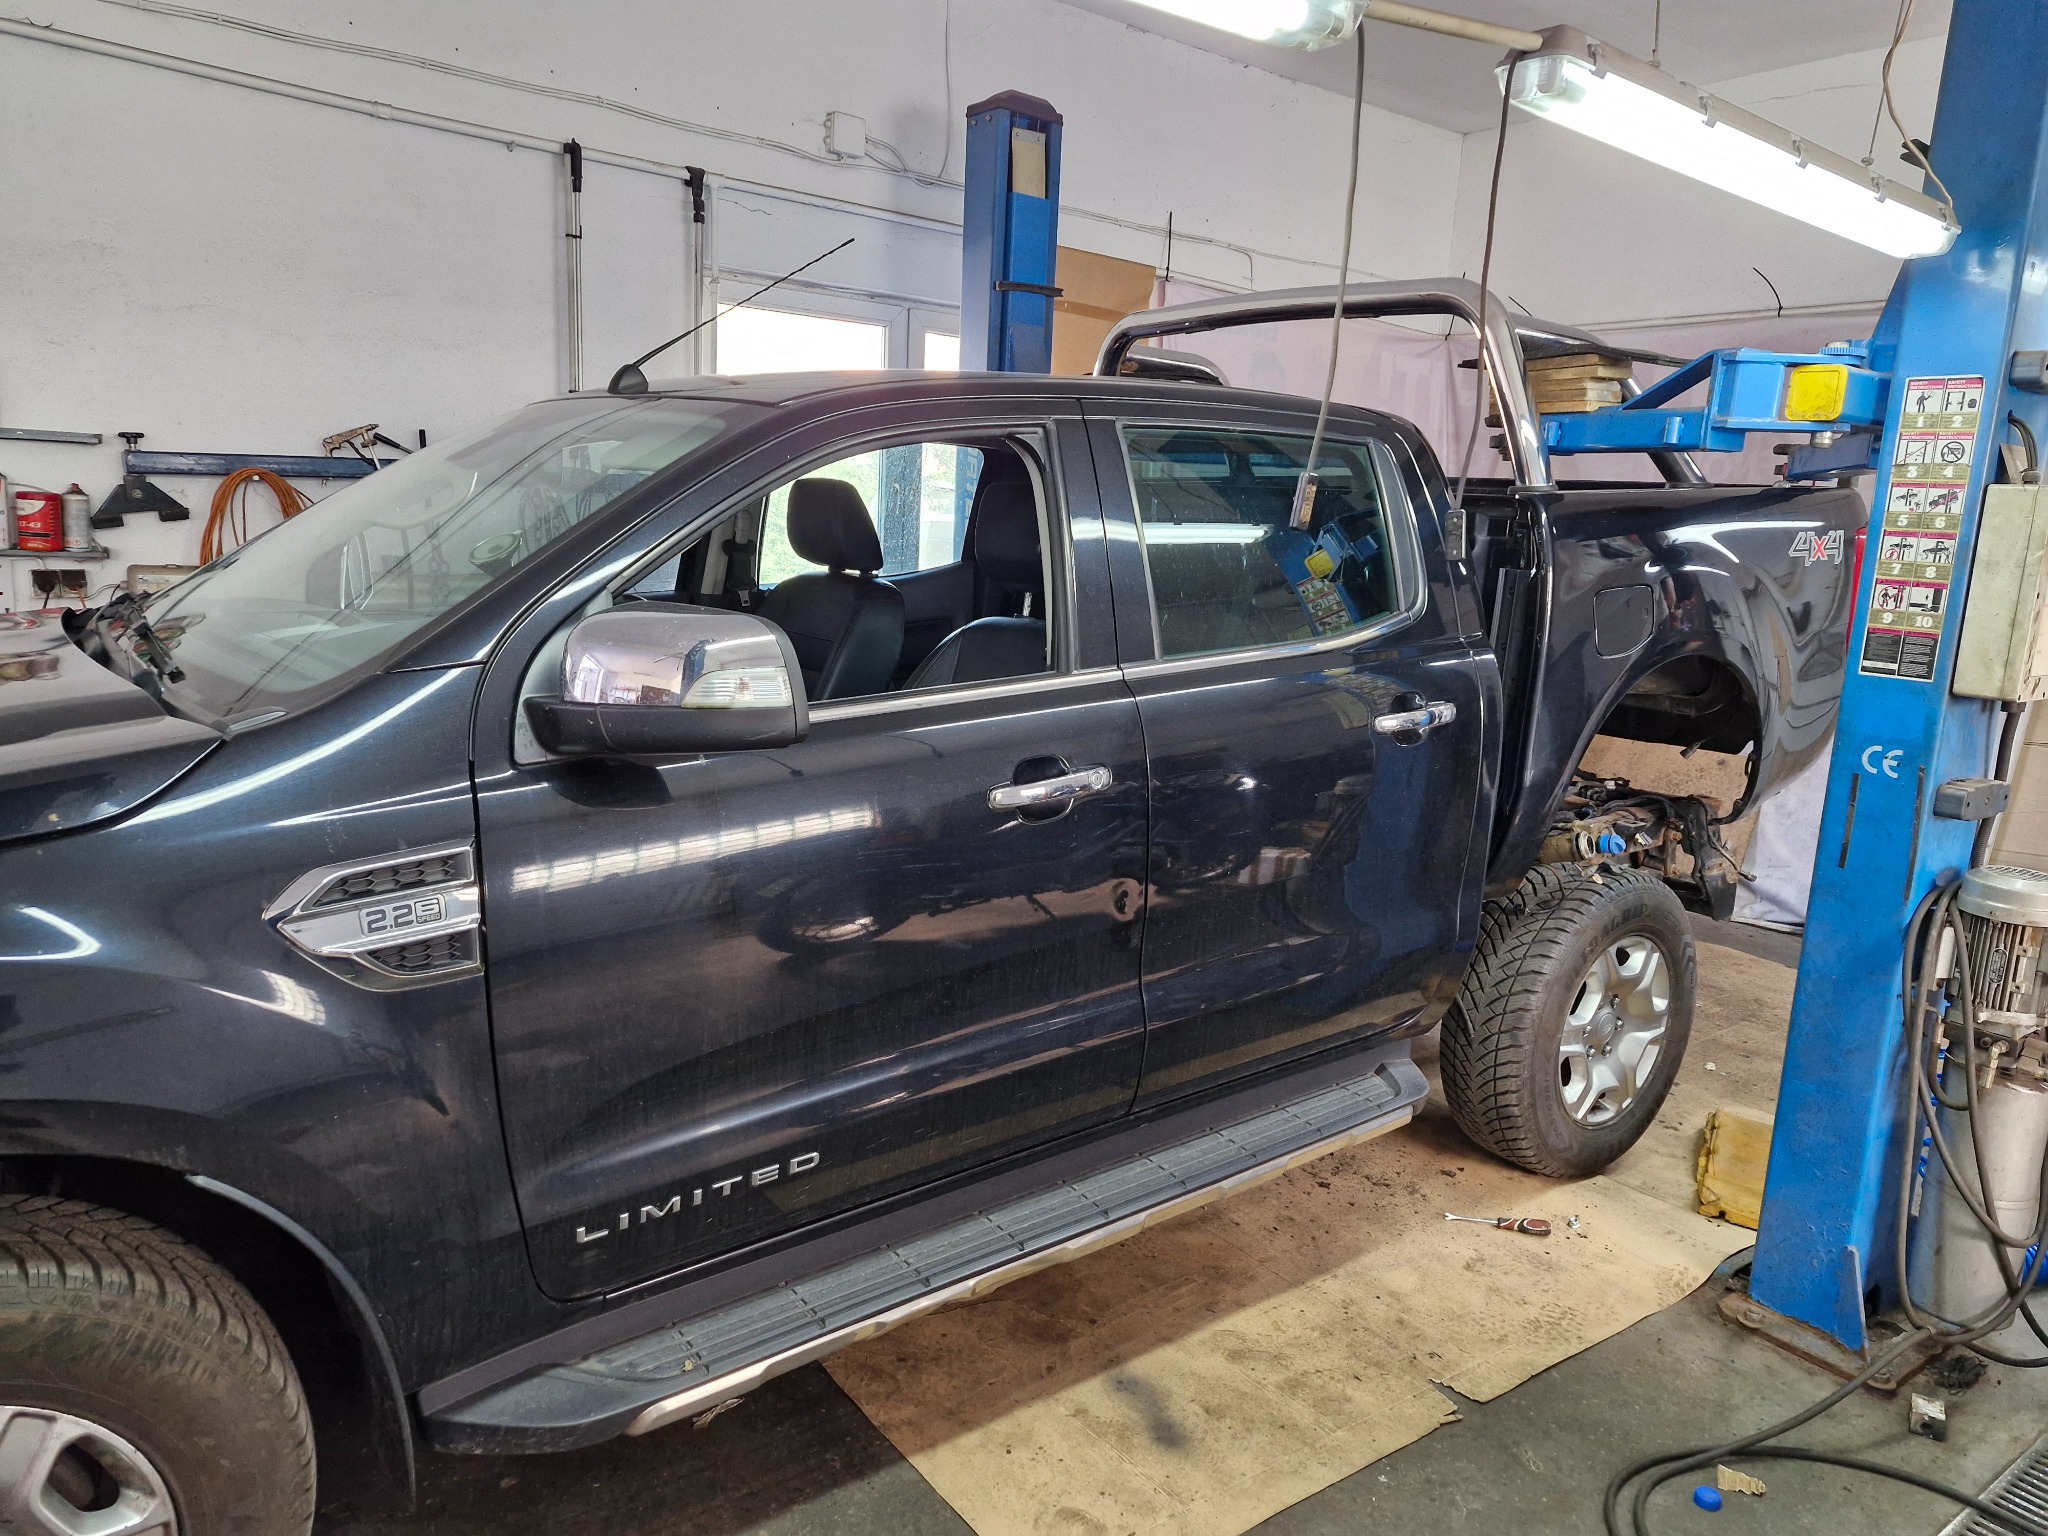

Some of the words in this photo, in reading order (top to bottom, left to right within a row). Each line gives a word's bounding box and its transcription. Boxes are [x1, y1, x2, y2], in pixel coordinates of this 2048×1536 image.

[1916, 416, 1925, 428] 1
[1951, 415, 1963, 428] 2
[1906, 466, 1918, 478] 3
[1943, 466, 1954, 478] 4
[1897, 514, 1909, 526] 5
[1935, 516, 1946, 528] 6
[1891, 563, 1902, 575] 7
[1925, 566, 1937, 578] 8
[1882, 612, 1893, 624] 9
[1914, 616, 1933, 628] 10
[1862, 745, 1904, 779] CE
[365, 903, 414, 933] 2.2
[417, 913, 440, 923] SPEED
[576, 1151, 820, 1243] LIMITED
